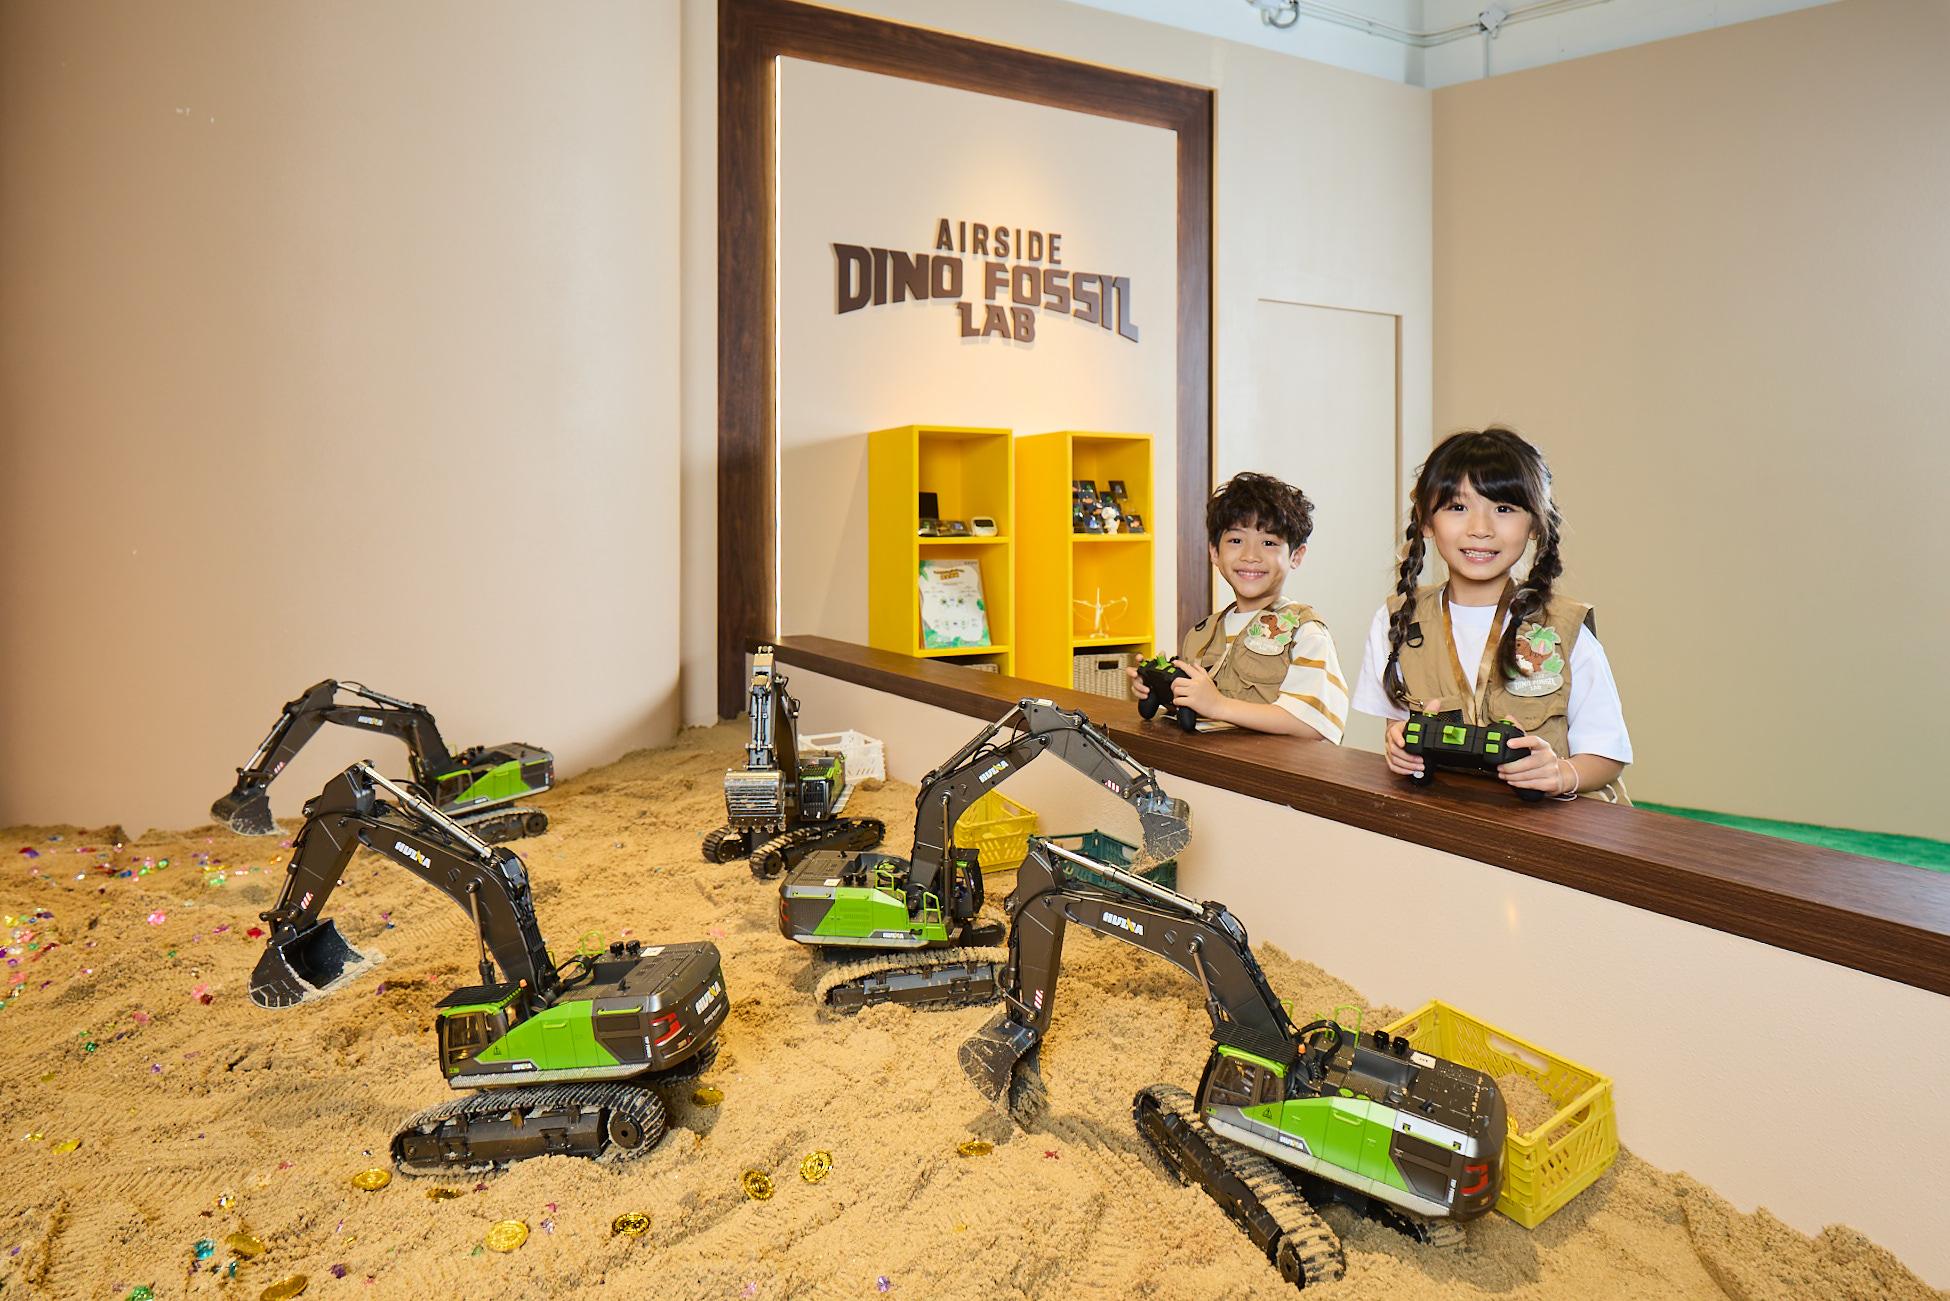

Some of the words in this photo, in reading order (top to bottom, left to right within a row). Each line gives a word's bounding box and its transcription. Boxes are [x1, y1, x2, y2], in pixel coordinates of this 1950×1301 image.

[936, 218, 1062, 265] AIRSIDE
[833, 243, 963, 314] DINO
[985, 261, 1139, 343] FOSSIL
[957, 302, 1036, 343] LAB
